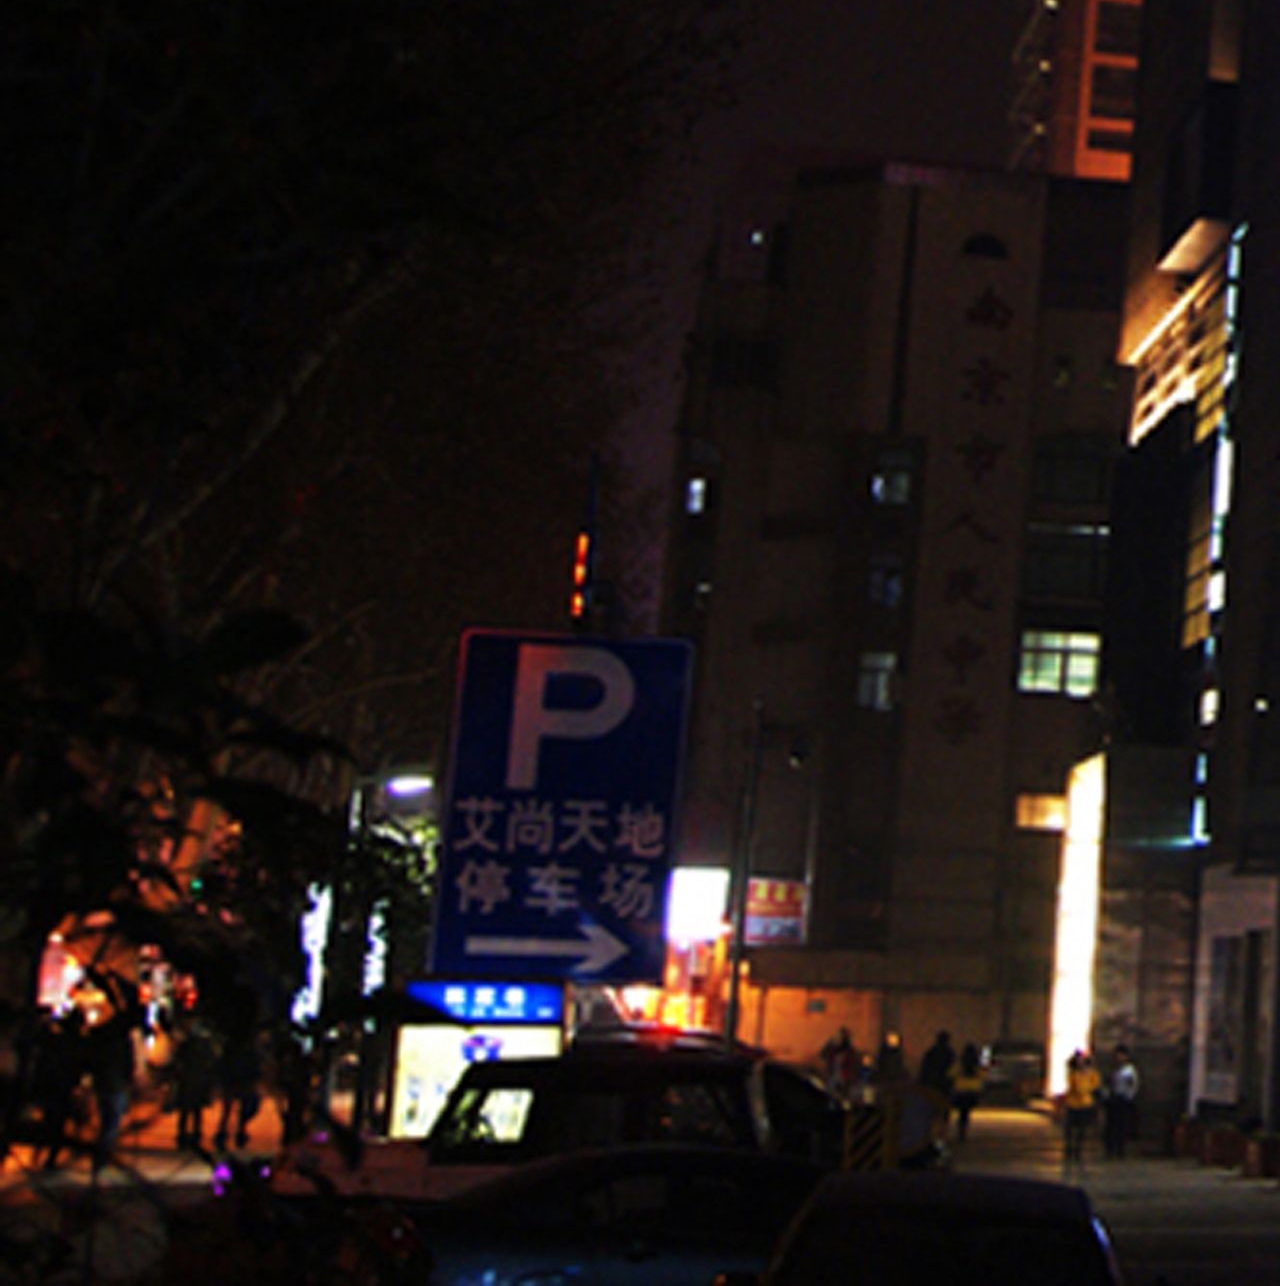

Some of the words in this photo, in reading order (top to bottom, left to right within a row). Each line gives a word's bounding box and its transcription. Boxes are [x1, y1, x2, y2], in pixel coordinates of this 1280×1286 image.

[504, 642, 636, 791] P
[454, 795, 666, 856] 艾尚天地
[454, 862, 658, 920] 停车场
